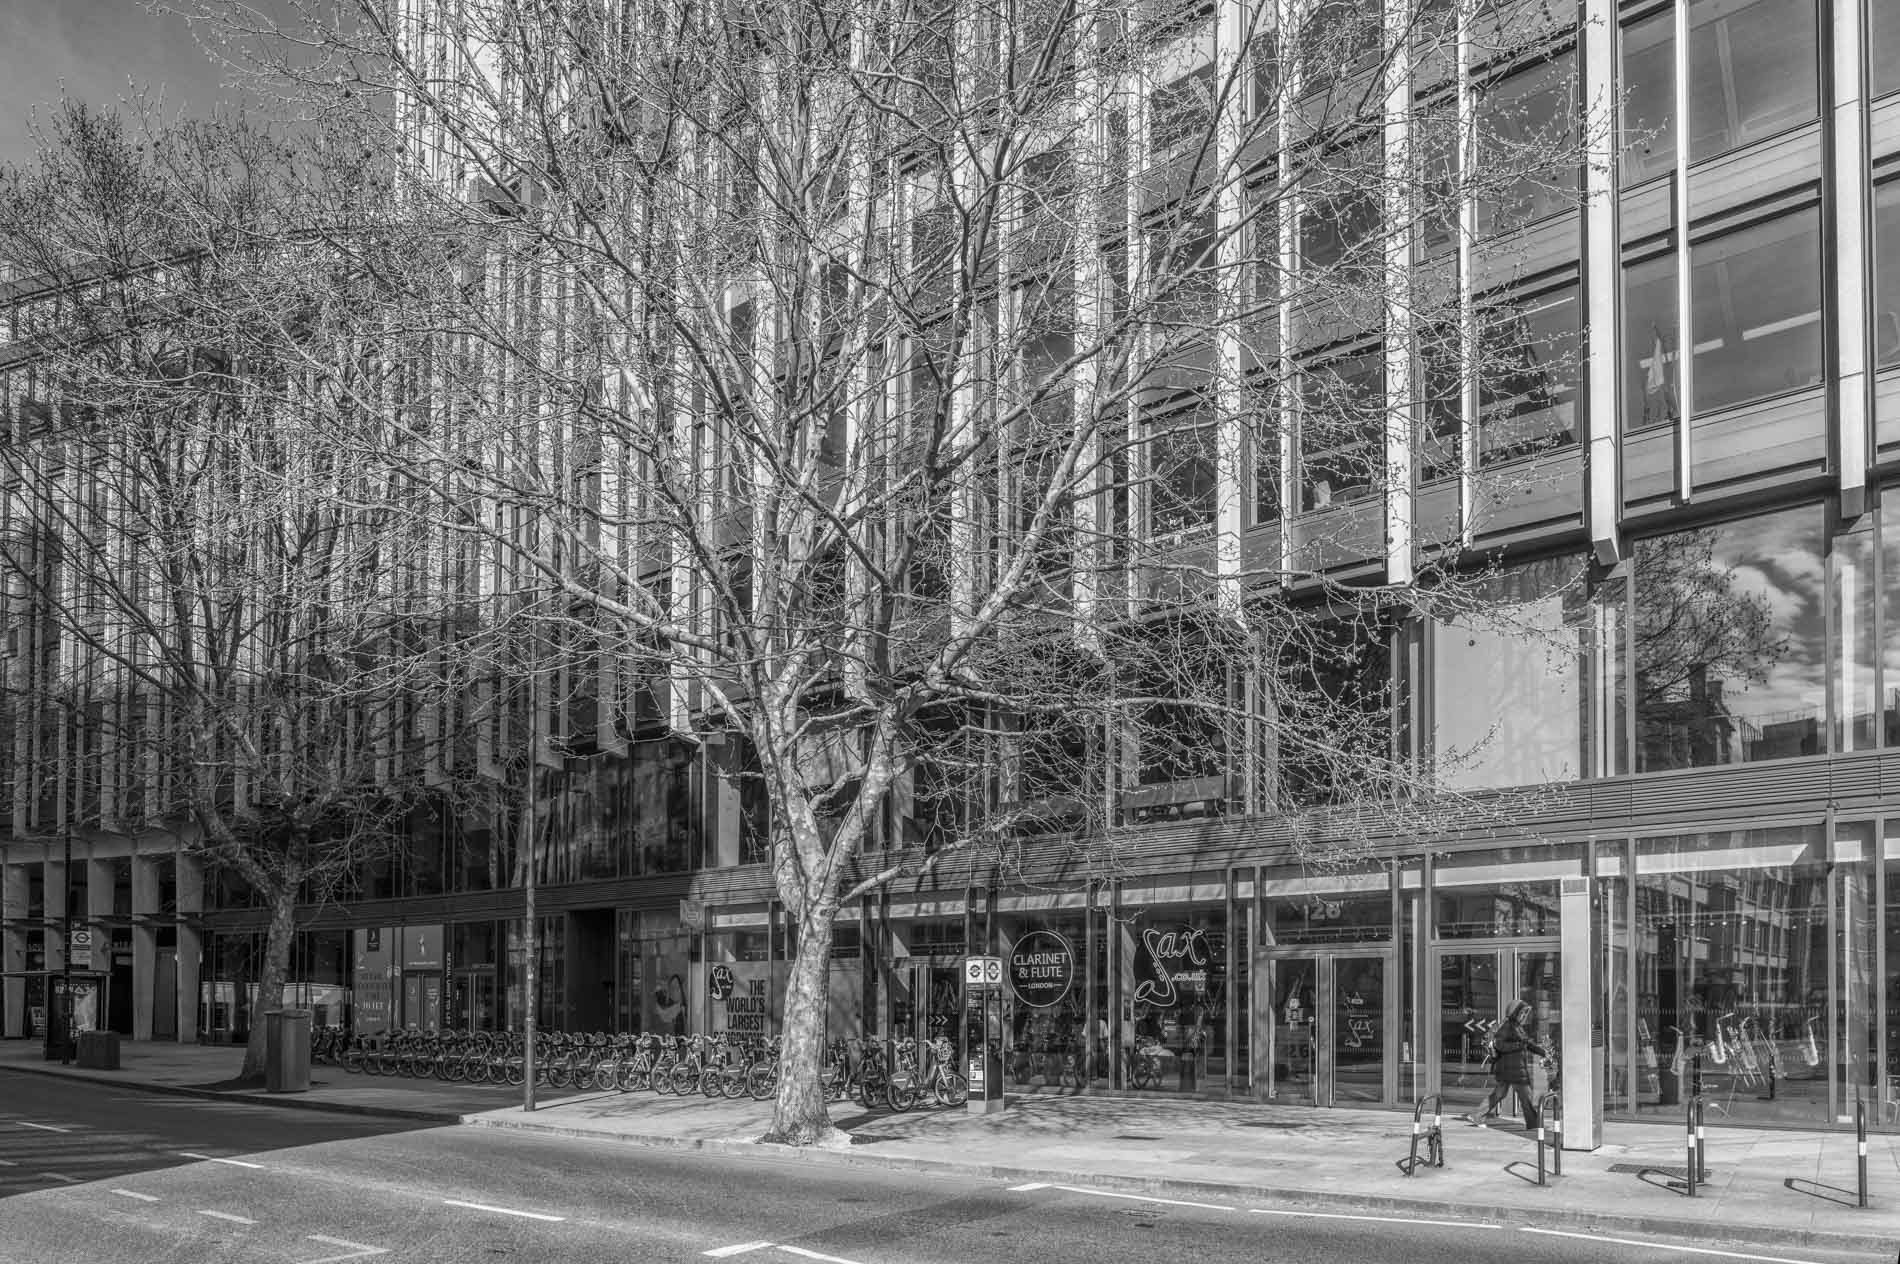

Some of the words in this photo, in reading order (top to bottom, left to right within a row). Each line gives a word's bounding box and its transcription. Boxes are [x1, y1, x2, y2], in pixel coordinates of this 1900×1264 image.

[1013, 952, 1067, 966] CLARINET
[1018, 967, 1029, 979] &
[1031, 966, 1064, 978] FLUTE
[749, 979, 765, 996] THE
[727, 997, 765, 1013] WORLD'S
[727, 1014, 764, 1032] LARGEST
